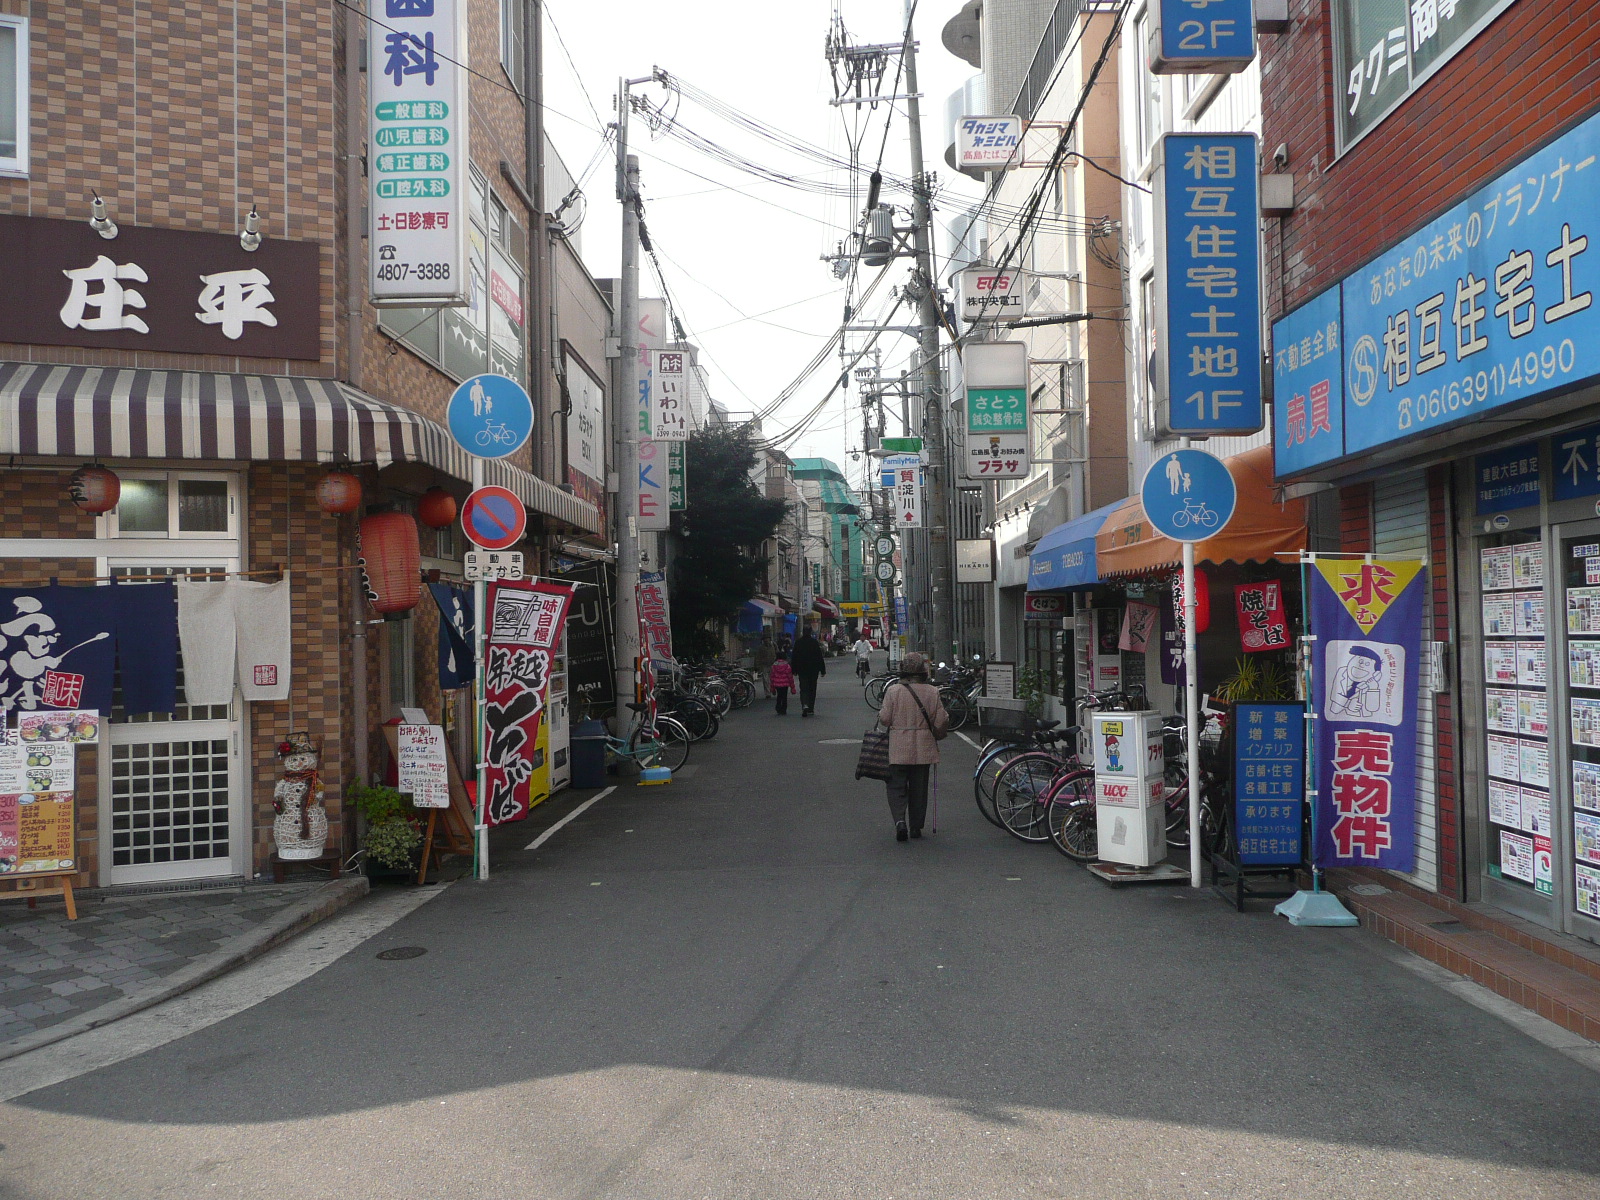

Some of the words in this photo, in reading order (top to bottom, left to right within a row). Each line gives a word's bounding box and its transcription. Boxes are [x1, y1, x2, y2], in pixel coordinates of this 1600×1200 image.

[1178, 20, 1235, 50] 2F
[379, 102, 445, 119] 一般歯科
[962, 120, 1011, 134] タカシマ
[379, 128, 445, 146] 小児歯科
[380, 154, 445, 171] 矯正歯科
[380, 180, 445, 197] 口腔外科
[1369, 154, 1597, 306] あなたの未来のプランナー
[1183, 144, 1239, 378] 相互住宅土地
[377, 263, 451, 281] 4807-3388
[1275, 320, 1339, 377] 不動産全般
[659, 381, 678, 425] いわい
[975, 395, 1020, 409] さとう
[1185, 390, 1244, 420] 1F
[971, 412, 1024, 426] 鍼灸整骨院
[1286, 378, 1331, 449] 売買
[978, 459, 1019, 474] プラザ
[1562, 435, 1600, 486] 不
[900, 470, 915, 483] 質
[902, 484, 915, 510] 淀川
[467, 554, 521, 564] 自動車
[1339, 564, 1397, 626] 求む
[1033, 598, 1058, 610] たばこ
[534, 598, 558, 643] 味自慢
[1240, 590, 1286, 645] 焼そば
[486, 645, 549, 695] 年越
[1248, 711, 1289, 724] 新築
[1245, 743, 1293, 755] インテリア
[1245, 764, 1293, 778] 店舗・住宅
[1245, 781, 1292, 795] 各種工事
[1331, 728, 1394, 860] 売物件
[1245, 805, 1293, 818] 承ります
[1240, 838, 1298, 855] 相互住宅土地
